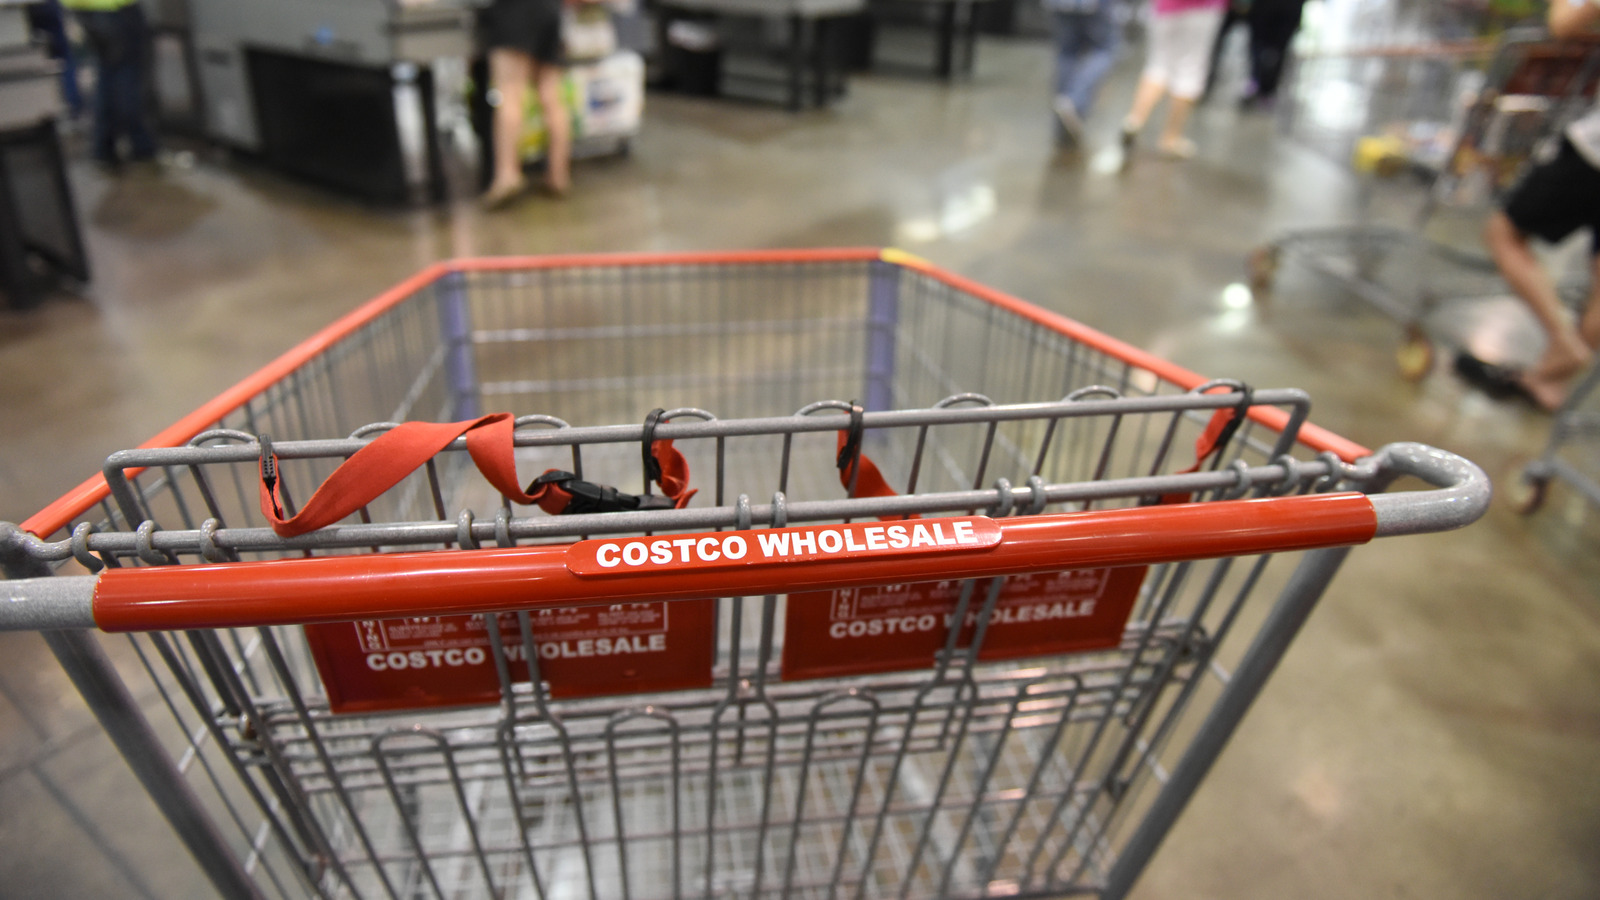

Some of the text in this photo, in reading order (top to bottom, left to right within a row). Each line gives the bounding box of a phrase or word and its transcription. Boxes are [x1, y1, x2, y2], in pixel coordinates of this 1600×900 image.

[597, 521, 977, 568] COSTCO WHOLESALE
[829, 614, 936, 639] COSTCO
[366, 648, 486, 671] COSTCO
